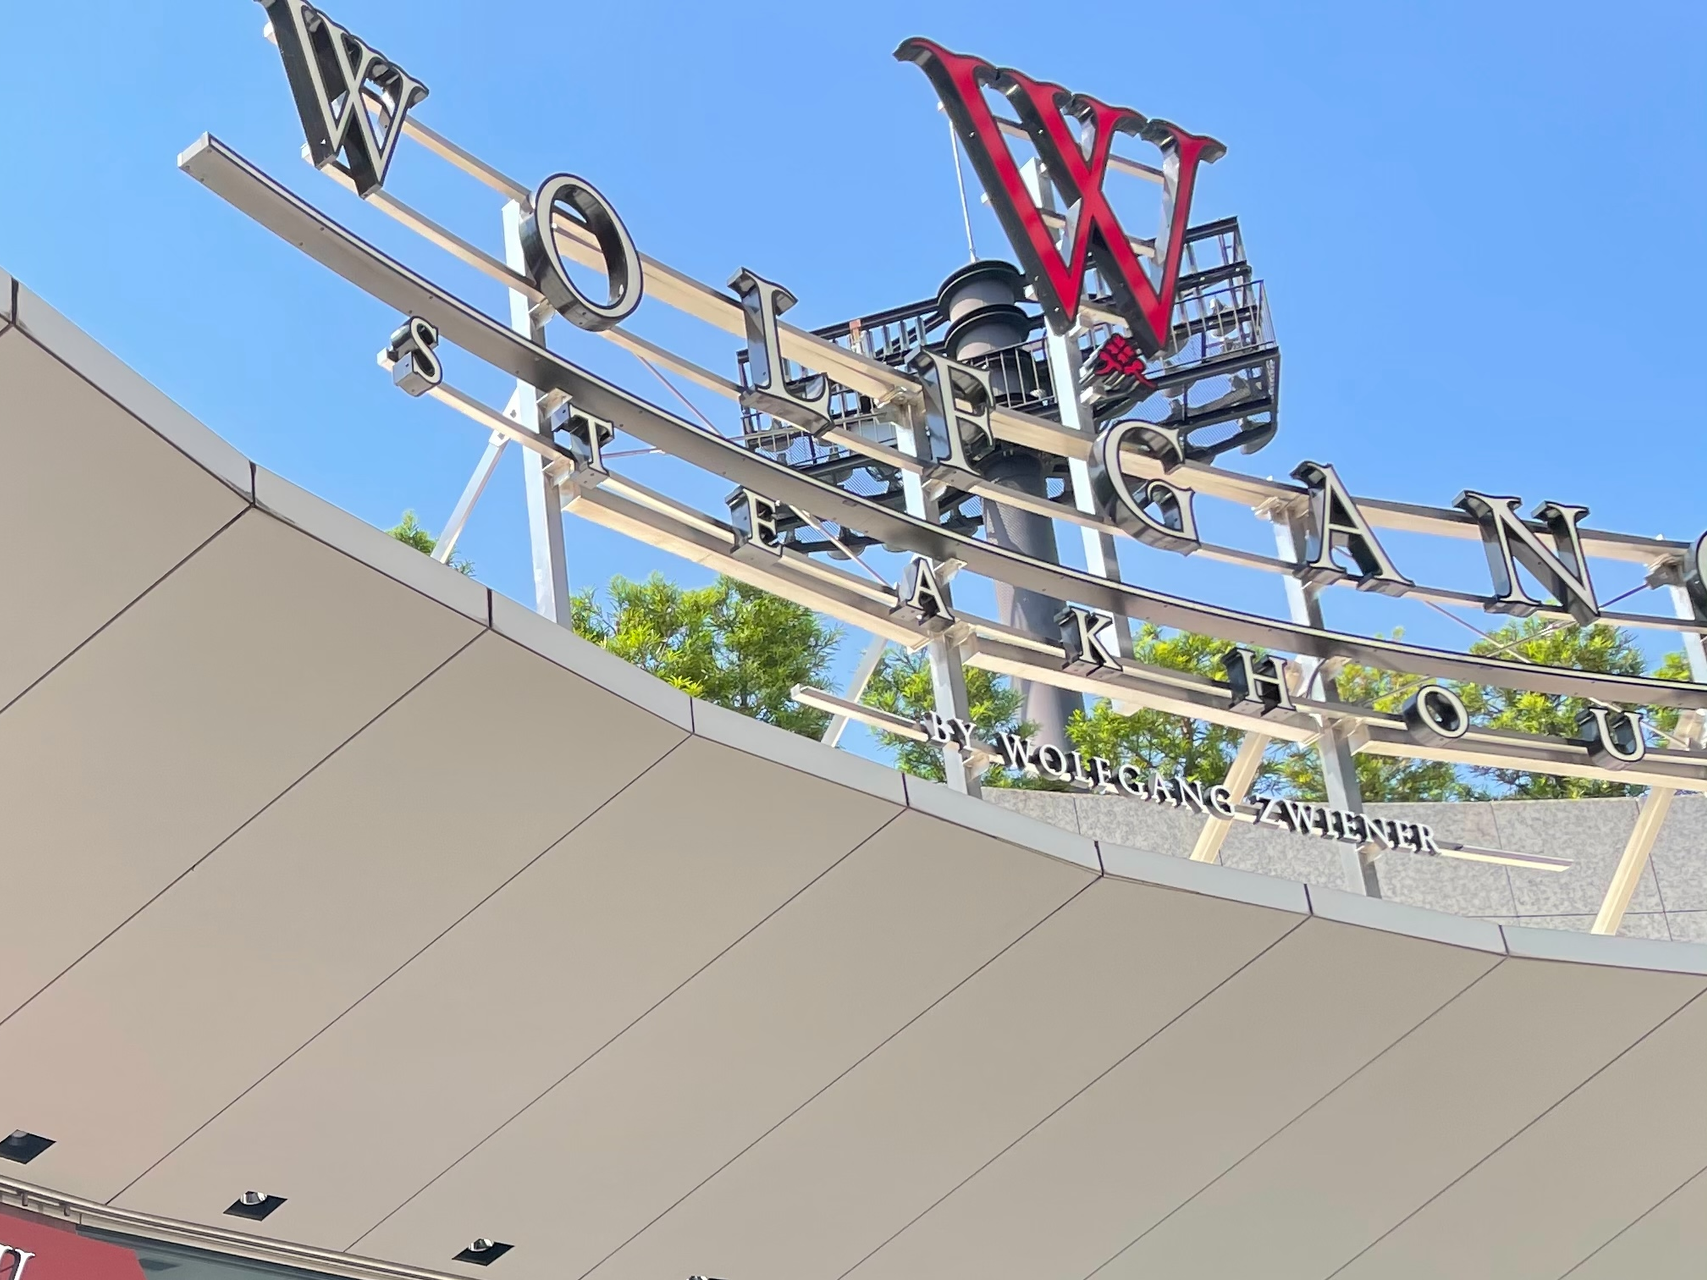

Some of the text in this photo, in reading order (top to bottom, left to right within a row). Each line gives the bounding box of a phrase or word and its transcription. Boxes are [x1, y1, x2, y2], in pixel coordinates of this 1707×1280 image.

[256, 0, 1707, 630] WOLFGAN
[894, 37, 1227, 358] W
[930, 712, 1442, 854] BY WOLFGANG ZWIENER
